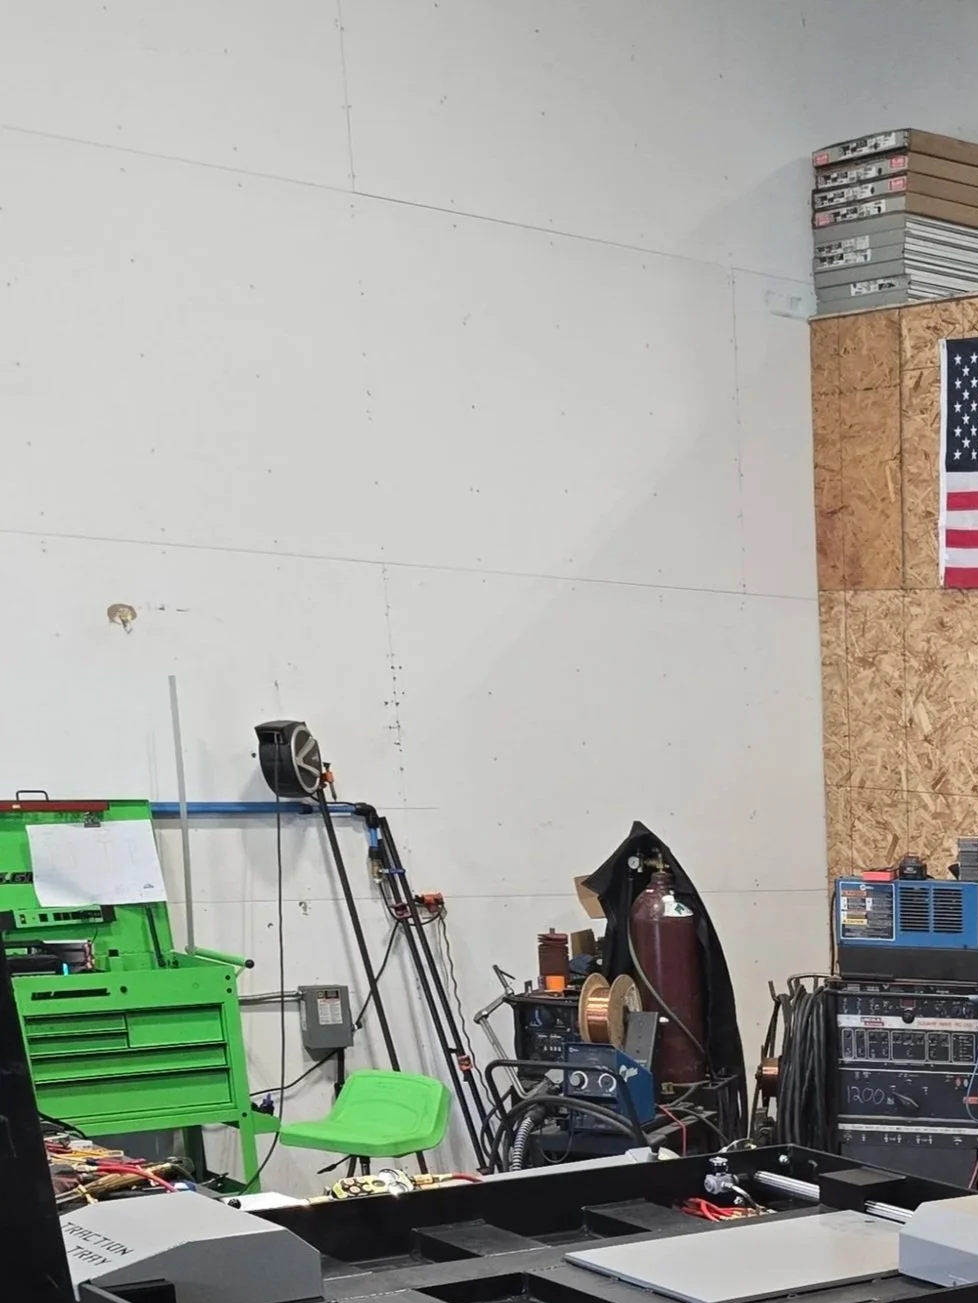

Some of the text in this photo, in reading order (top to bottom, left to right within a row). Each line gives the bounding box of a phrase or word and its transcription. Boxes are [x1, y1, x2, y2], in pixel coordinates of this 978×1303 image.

[847, 1085, 885, 1105] 1200
[61, 1222, 135, 1255] TRACTION
[67, 1245, 112, 1266] TRAY
